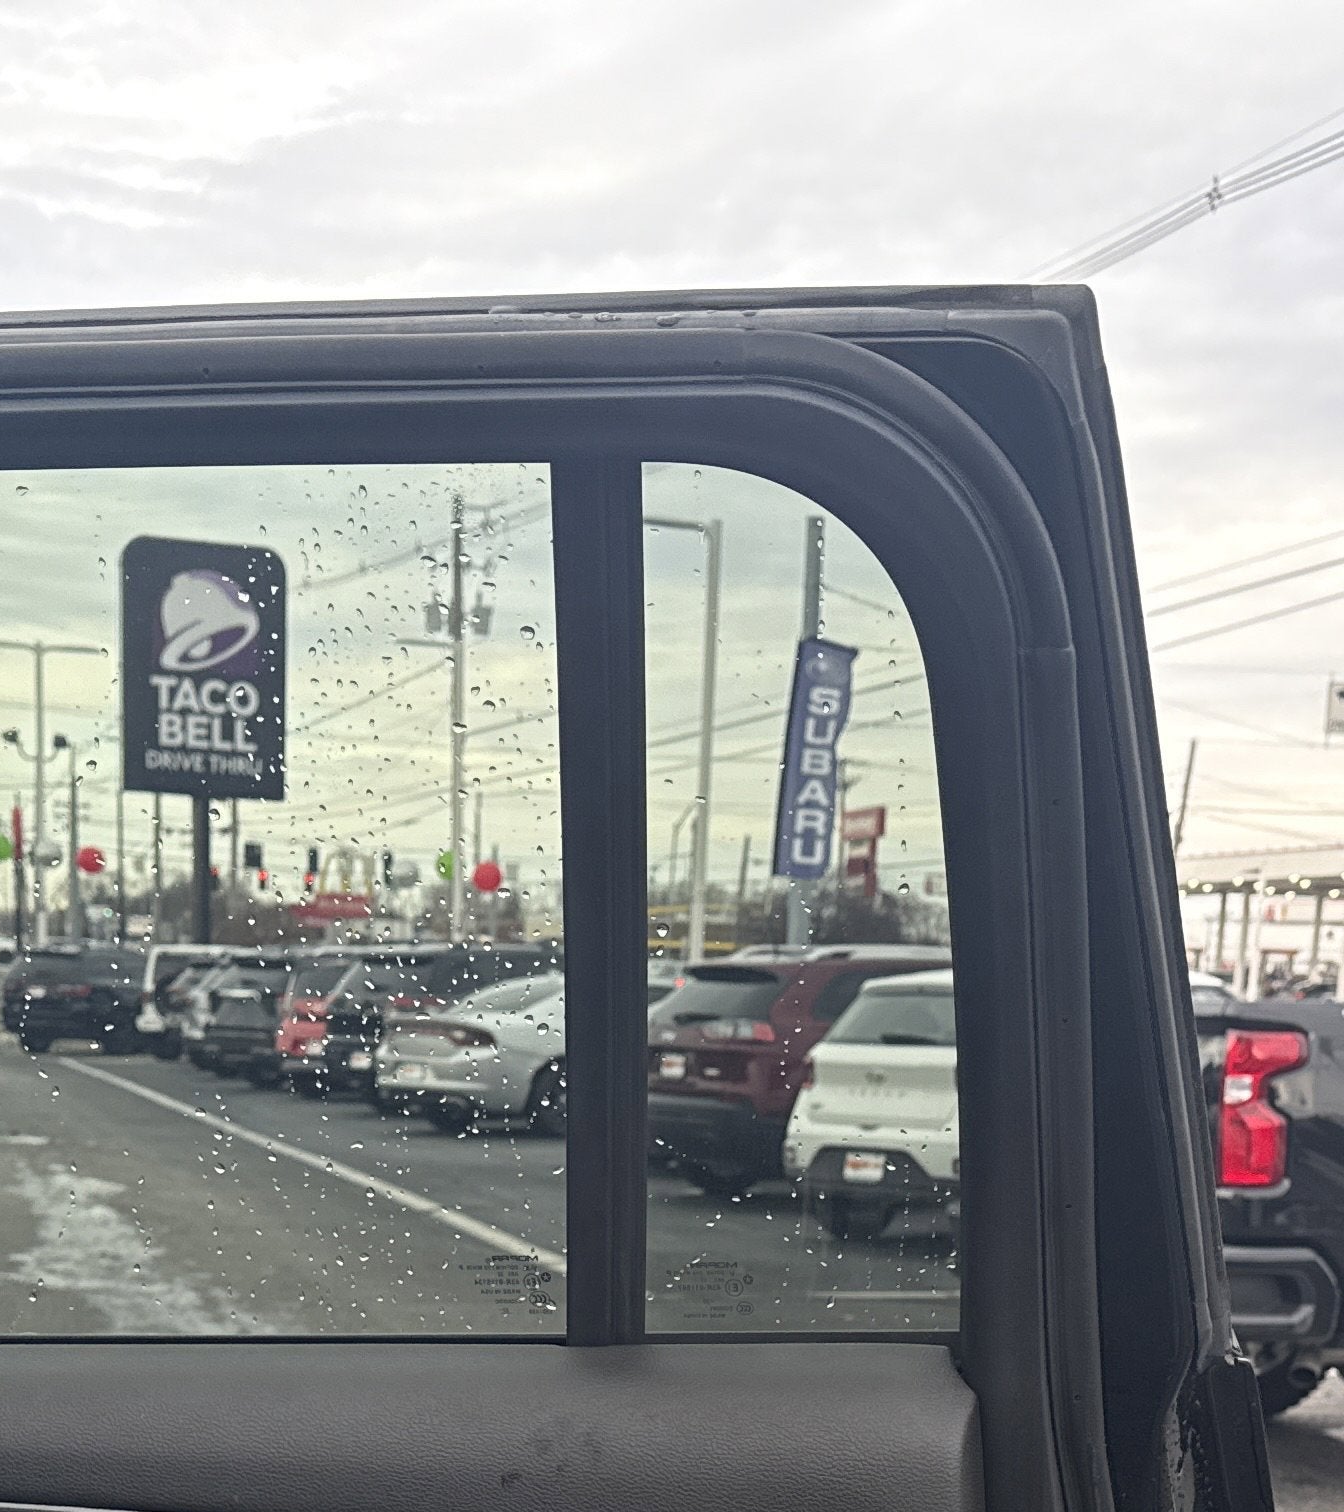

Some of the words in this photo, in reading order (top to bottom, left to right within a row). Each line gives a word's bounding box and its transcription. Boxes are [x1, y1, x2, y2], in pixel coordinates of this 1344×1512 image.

[149, 674, 260, 717] TACO
[158, 712, 258, 753] BELL
[145, 748, 204, 773] DRIVE
[792, 687, 842, 866] SUBARU
